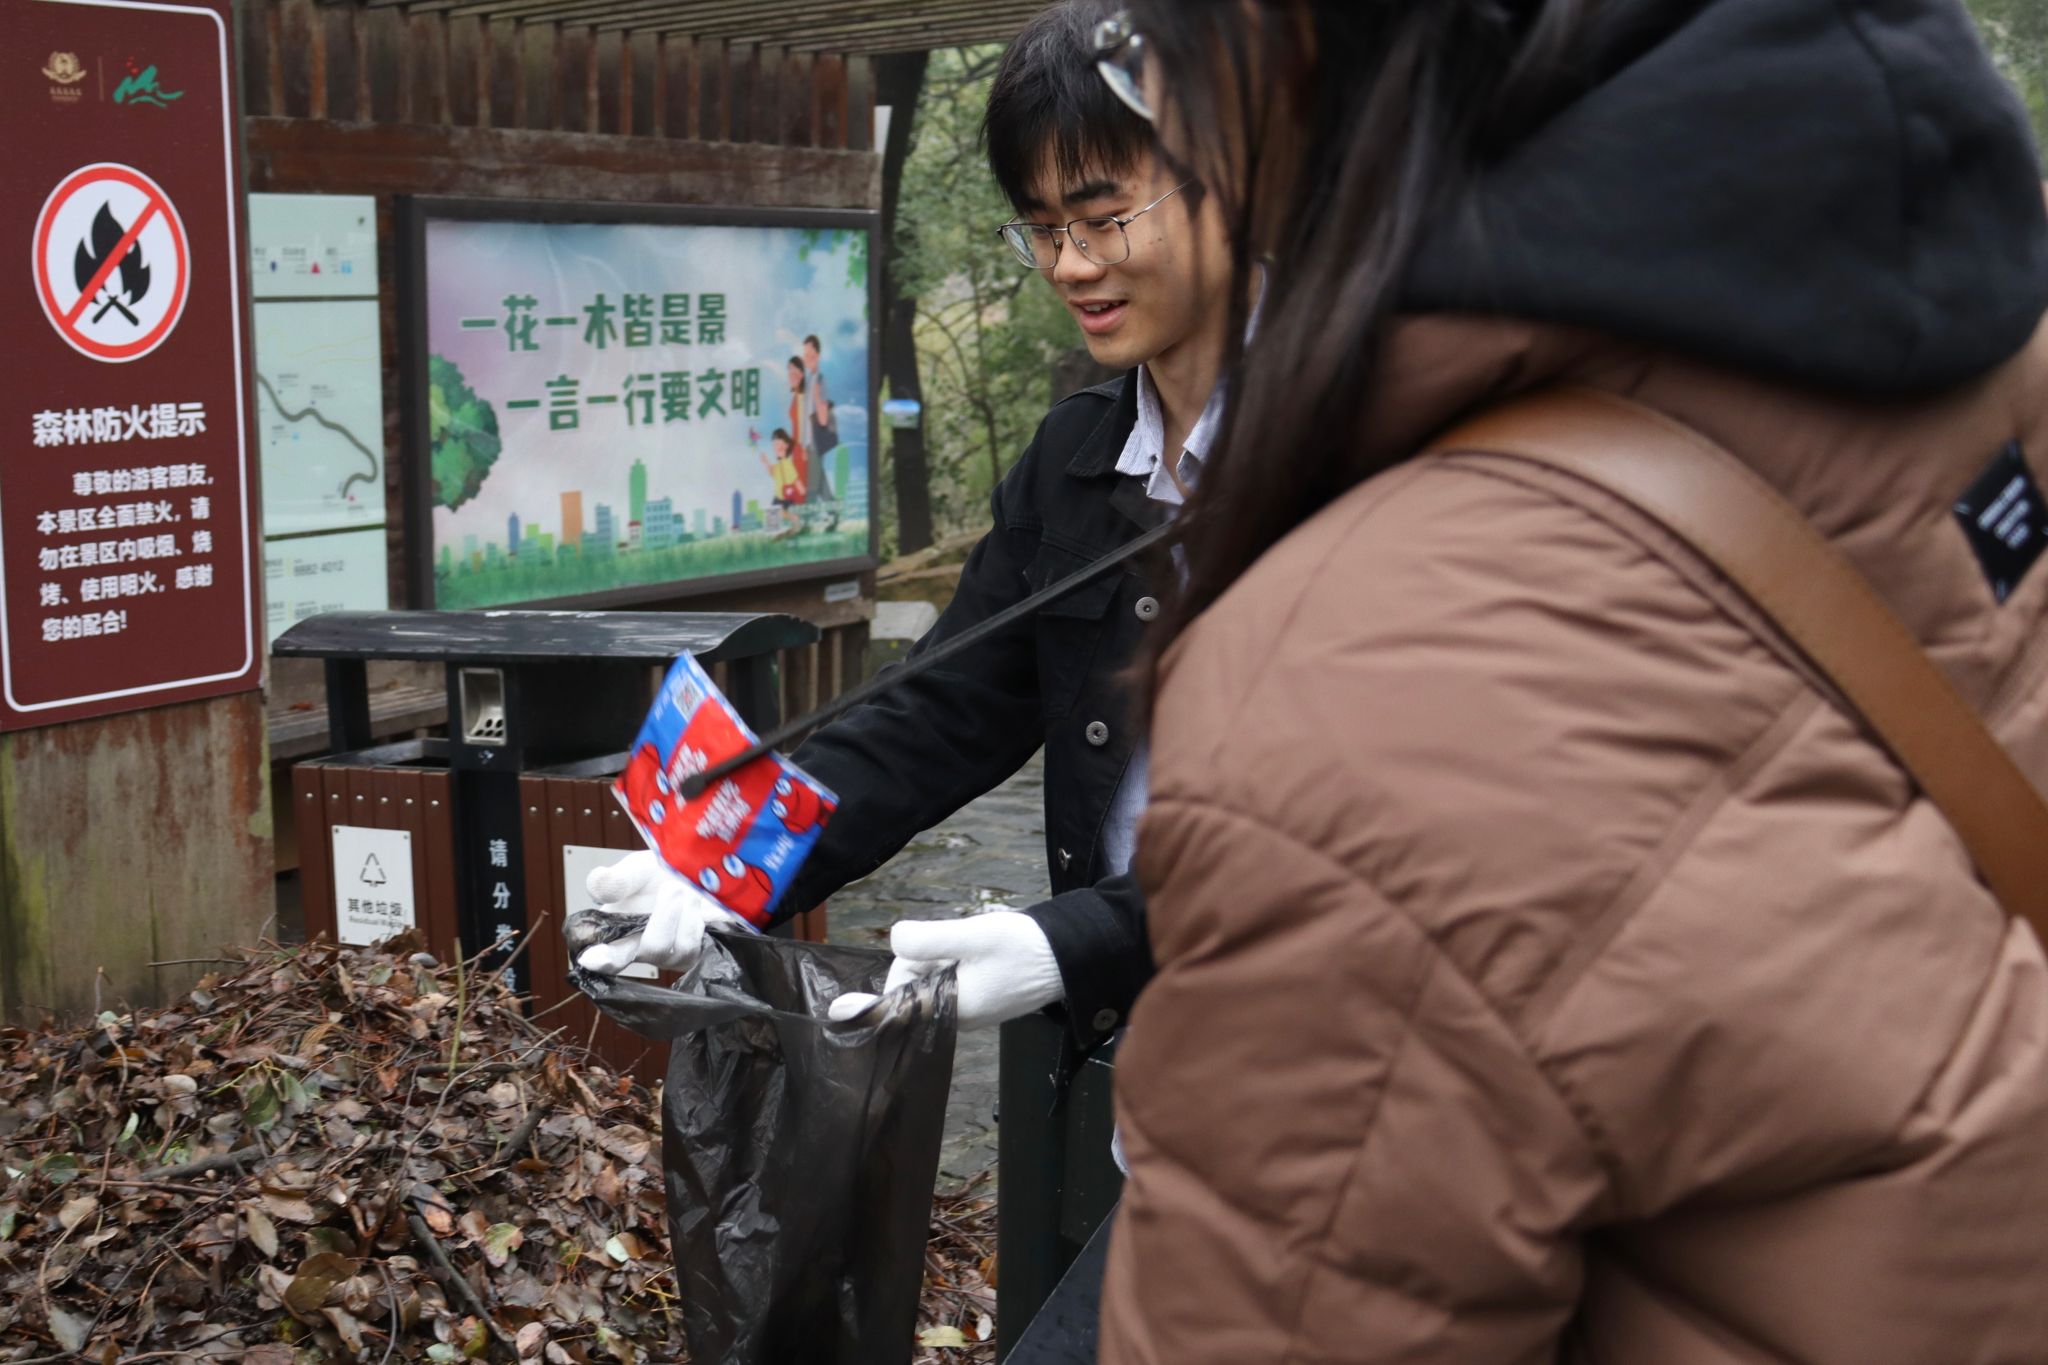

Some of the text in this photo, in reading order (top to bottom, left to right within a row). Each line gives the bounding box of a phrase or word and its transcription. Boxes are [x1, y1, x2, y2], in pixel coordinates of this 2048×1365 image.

[461, 293, 727, 352] 一花一木皆是景
[507, 367, 760, 430] 一言一行要文明
[32, 402, 207, 448] 森林防火提示
[348, 898, 402, 916] 其他垃圾
